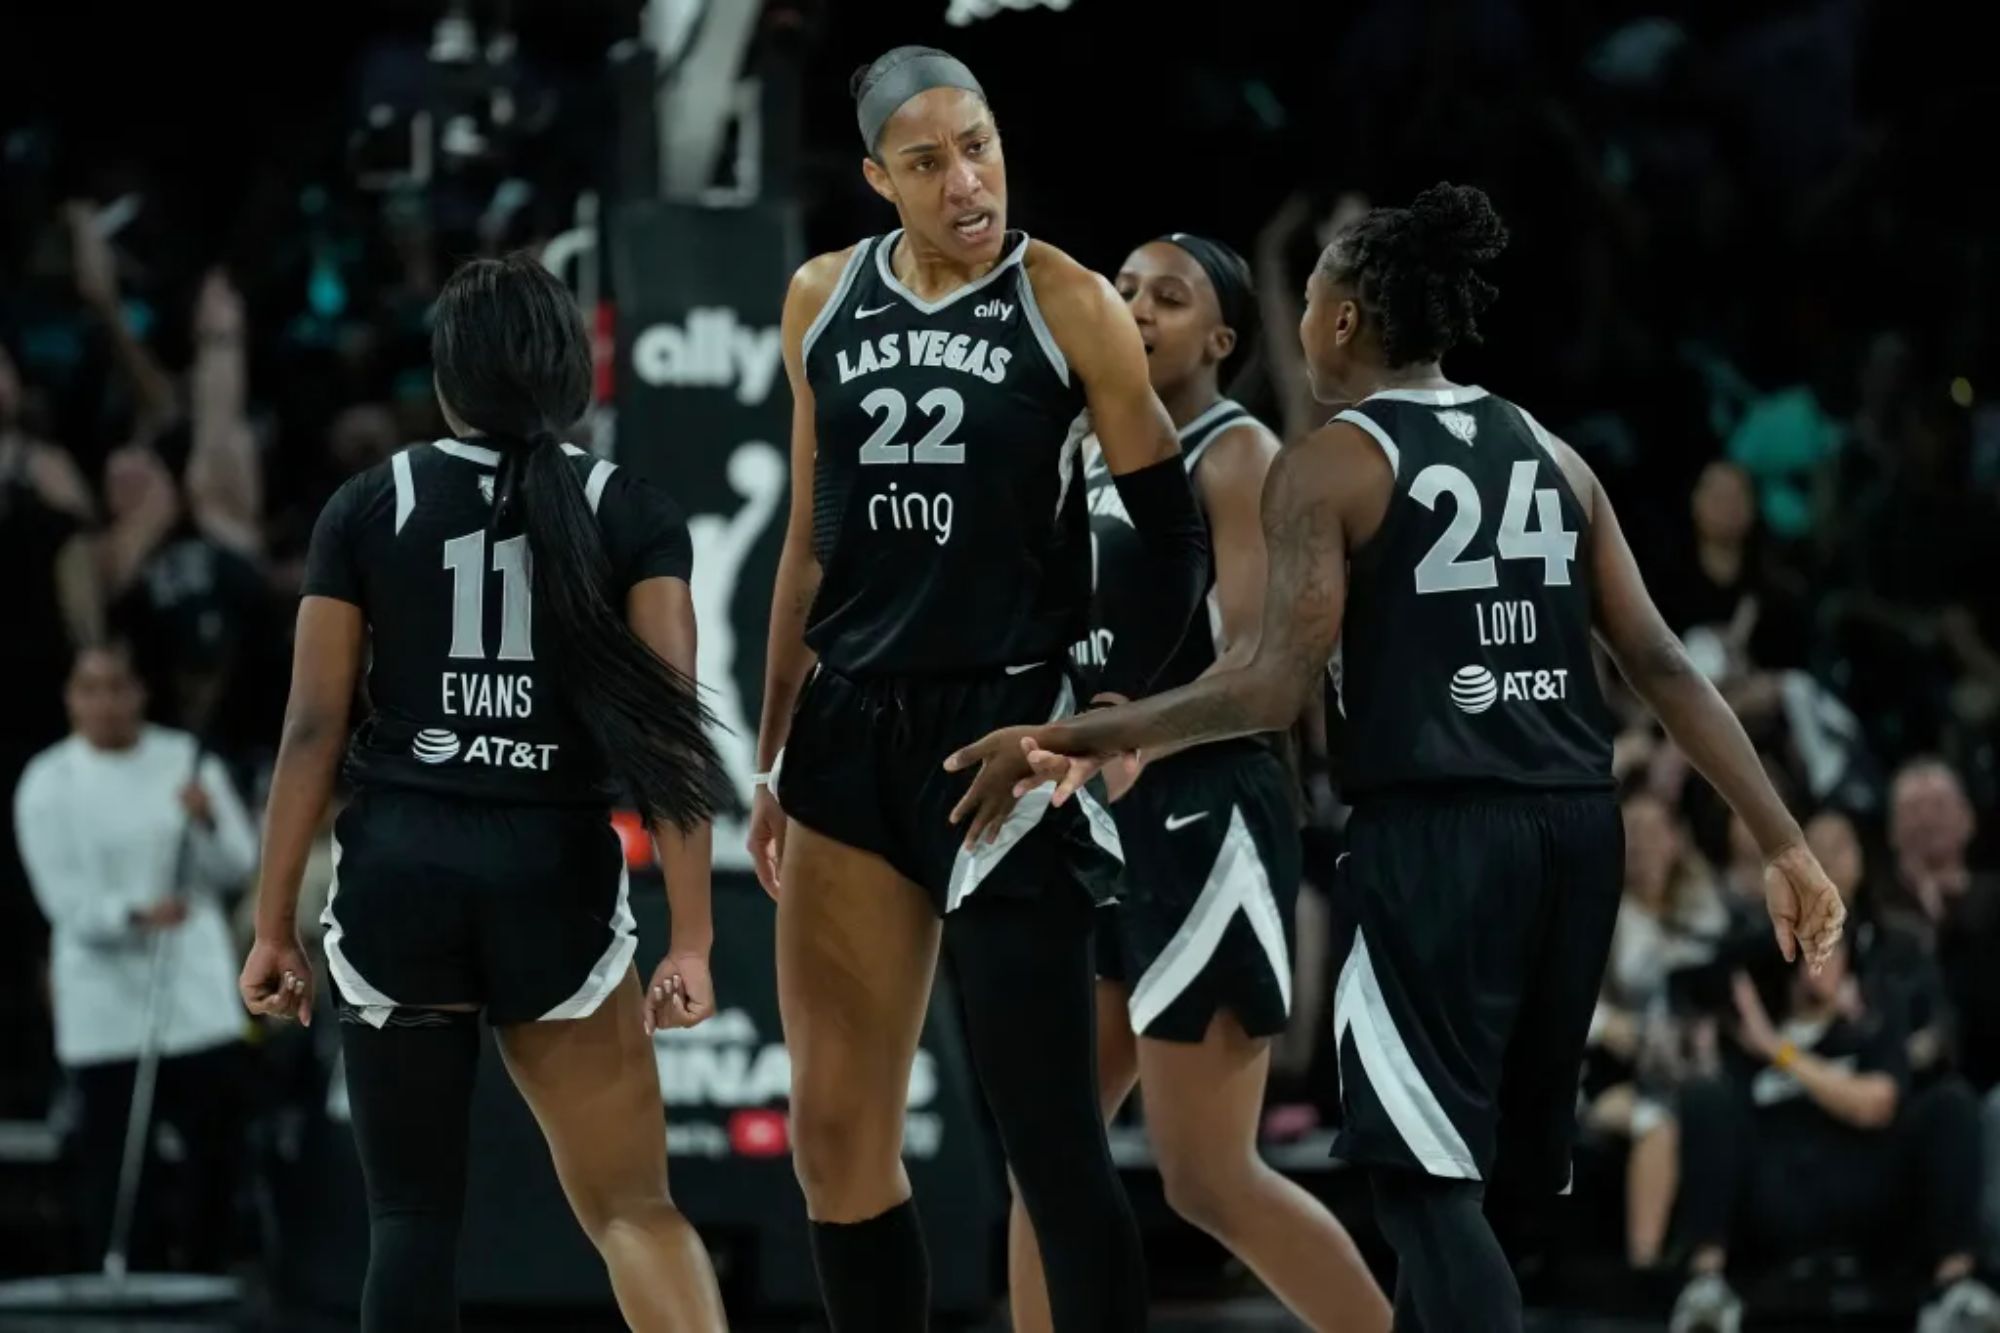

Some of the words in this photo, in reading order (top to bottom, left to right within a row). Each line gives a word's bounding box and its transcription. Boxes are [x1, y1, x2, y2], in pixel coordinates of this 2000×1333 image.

[973, 299, 1014, 321] ally
[633, 306, 783, 404] ally
[836, 333, 901, 384] LAS
[907, 329, 1013, 384] VEGAS
[859, 387, 966, 465] 22
[868, 482, 954, 546] ring
[1408, 460, 1578, 594] 24
[443, 529, 534, 661] 11
[1476, 600, 1537, 646] LOYD
[442, 671, 532, 718] EVANS
[1502, 670, 1568, 701] AT&T
[463, 735, 559, 771] AT&T
